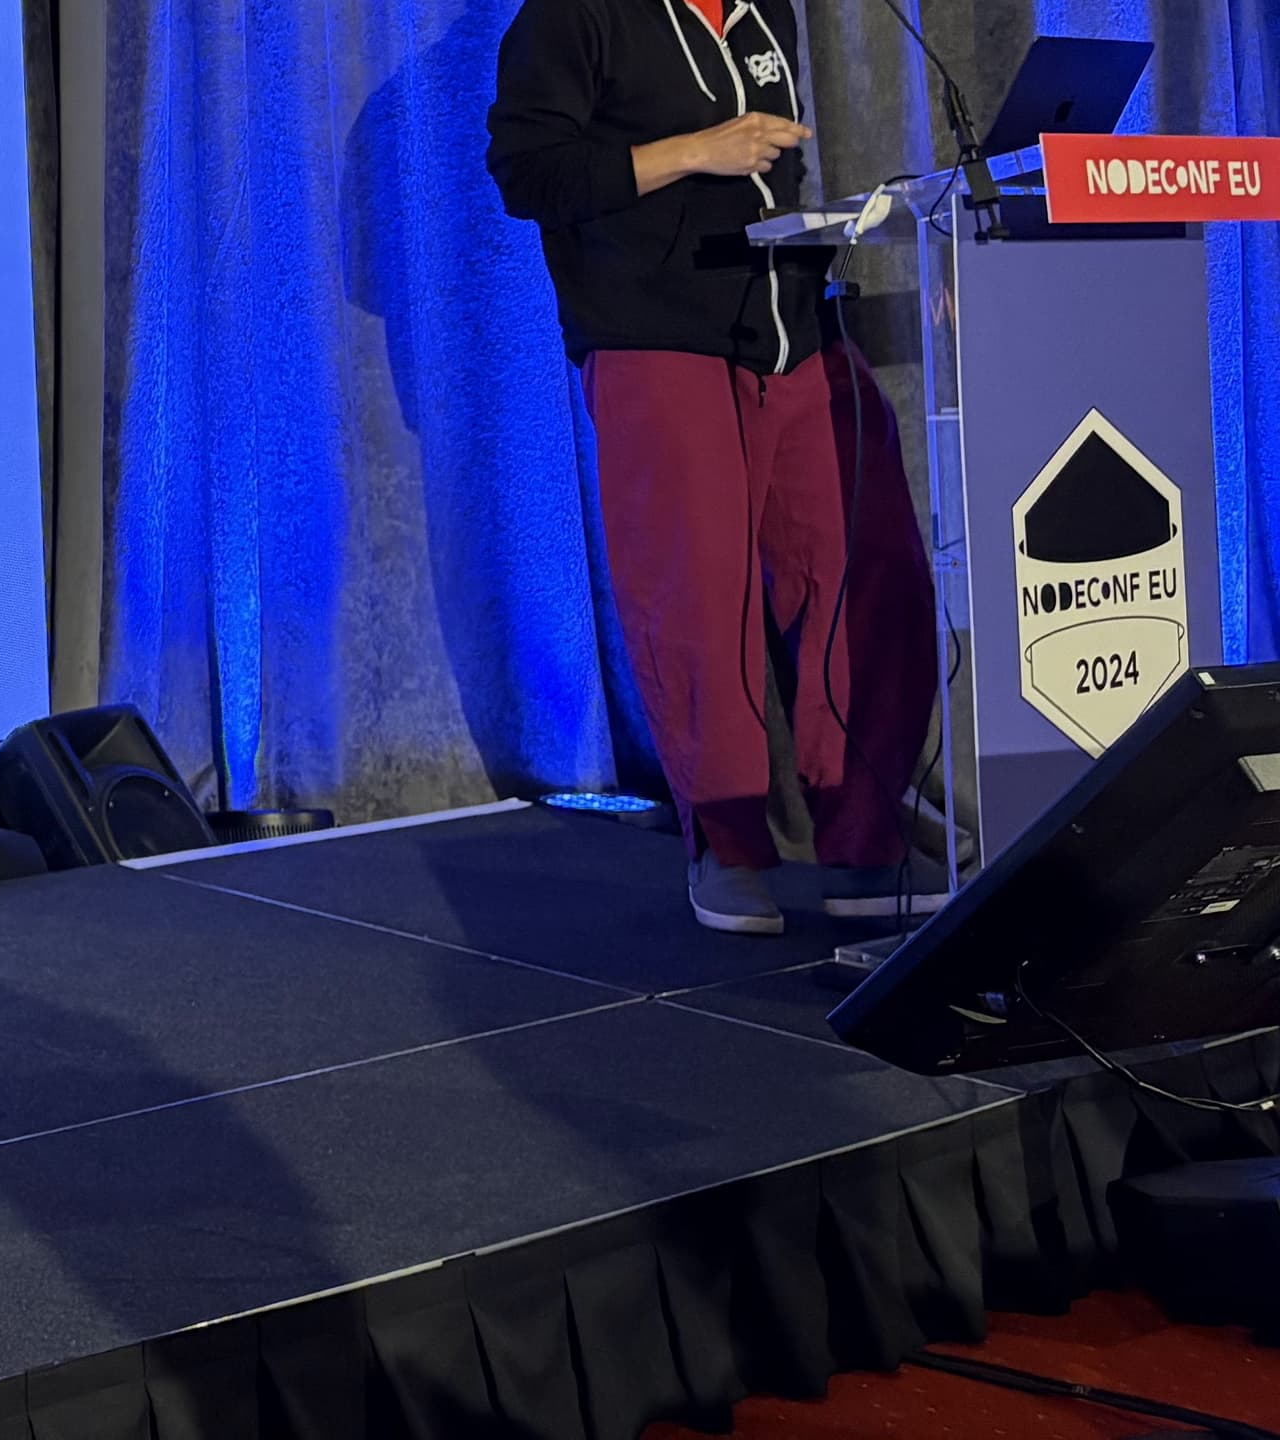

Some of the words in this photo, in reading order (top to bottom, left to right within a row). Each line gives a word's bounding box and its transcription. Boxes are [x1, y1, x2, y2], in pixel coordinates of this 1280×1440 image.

[1227, 160, 1261, 196] EU
[1148, 568, 1178, 601] EU
[1075, 650, 1141, 695] 2024
